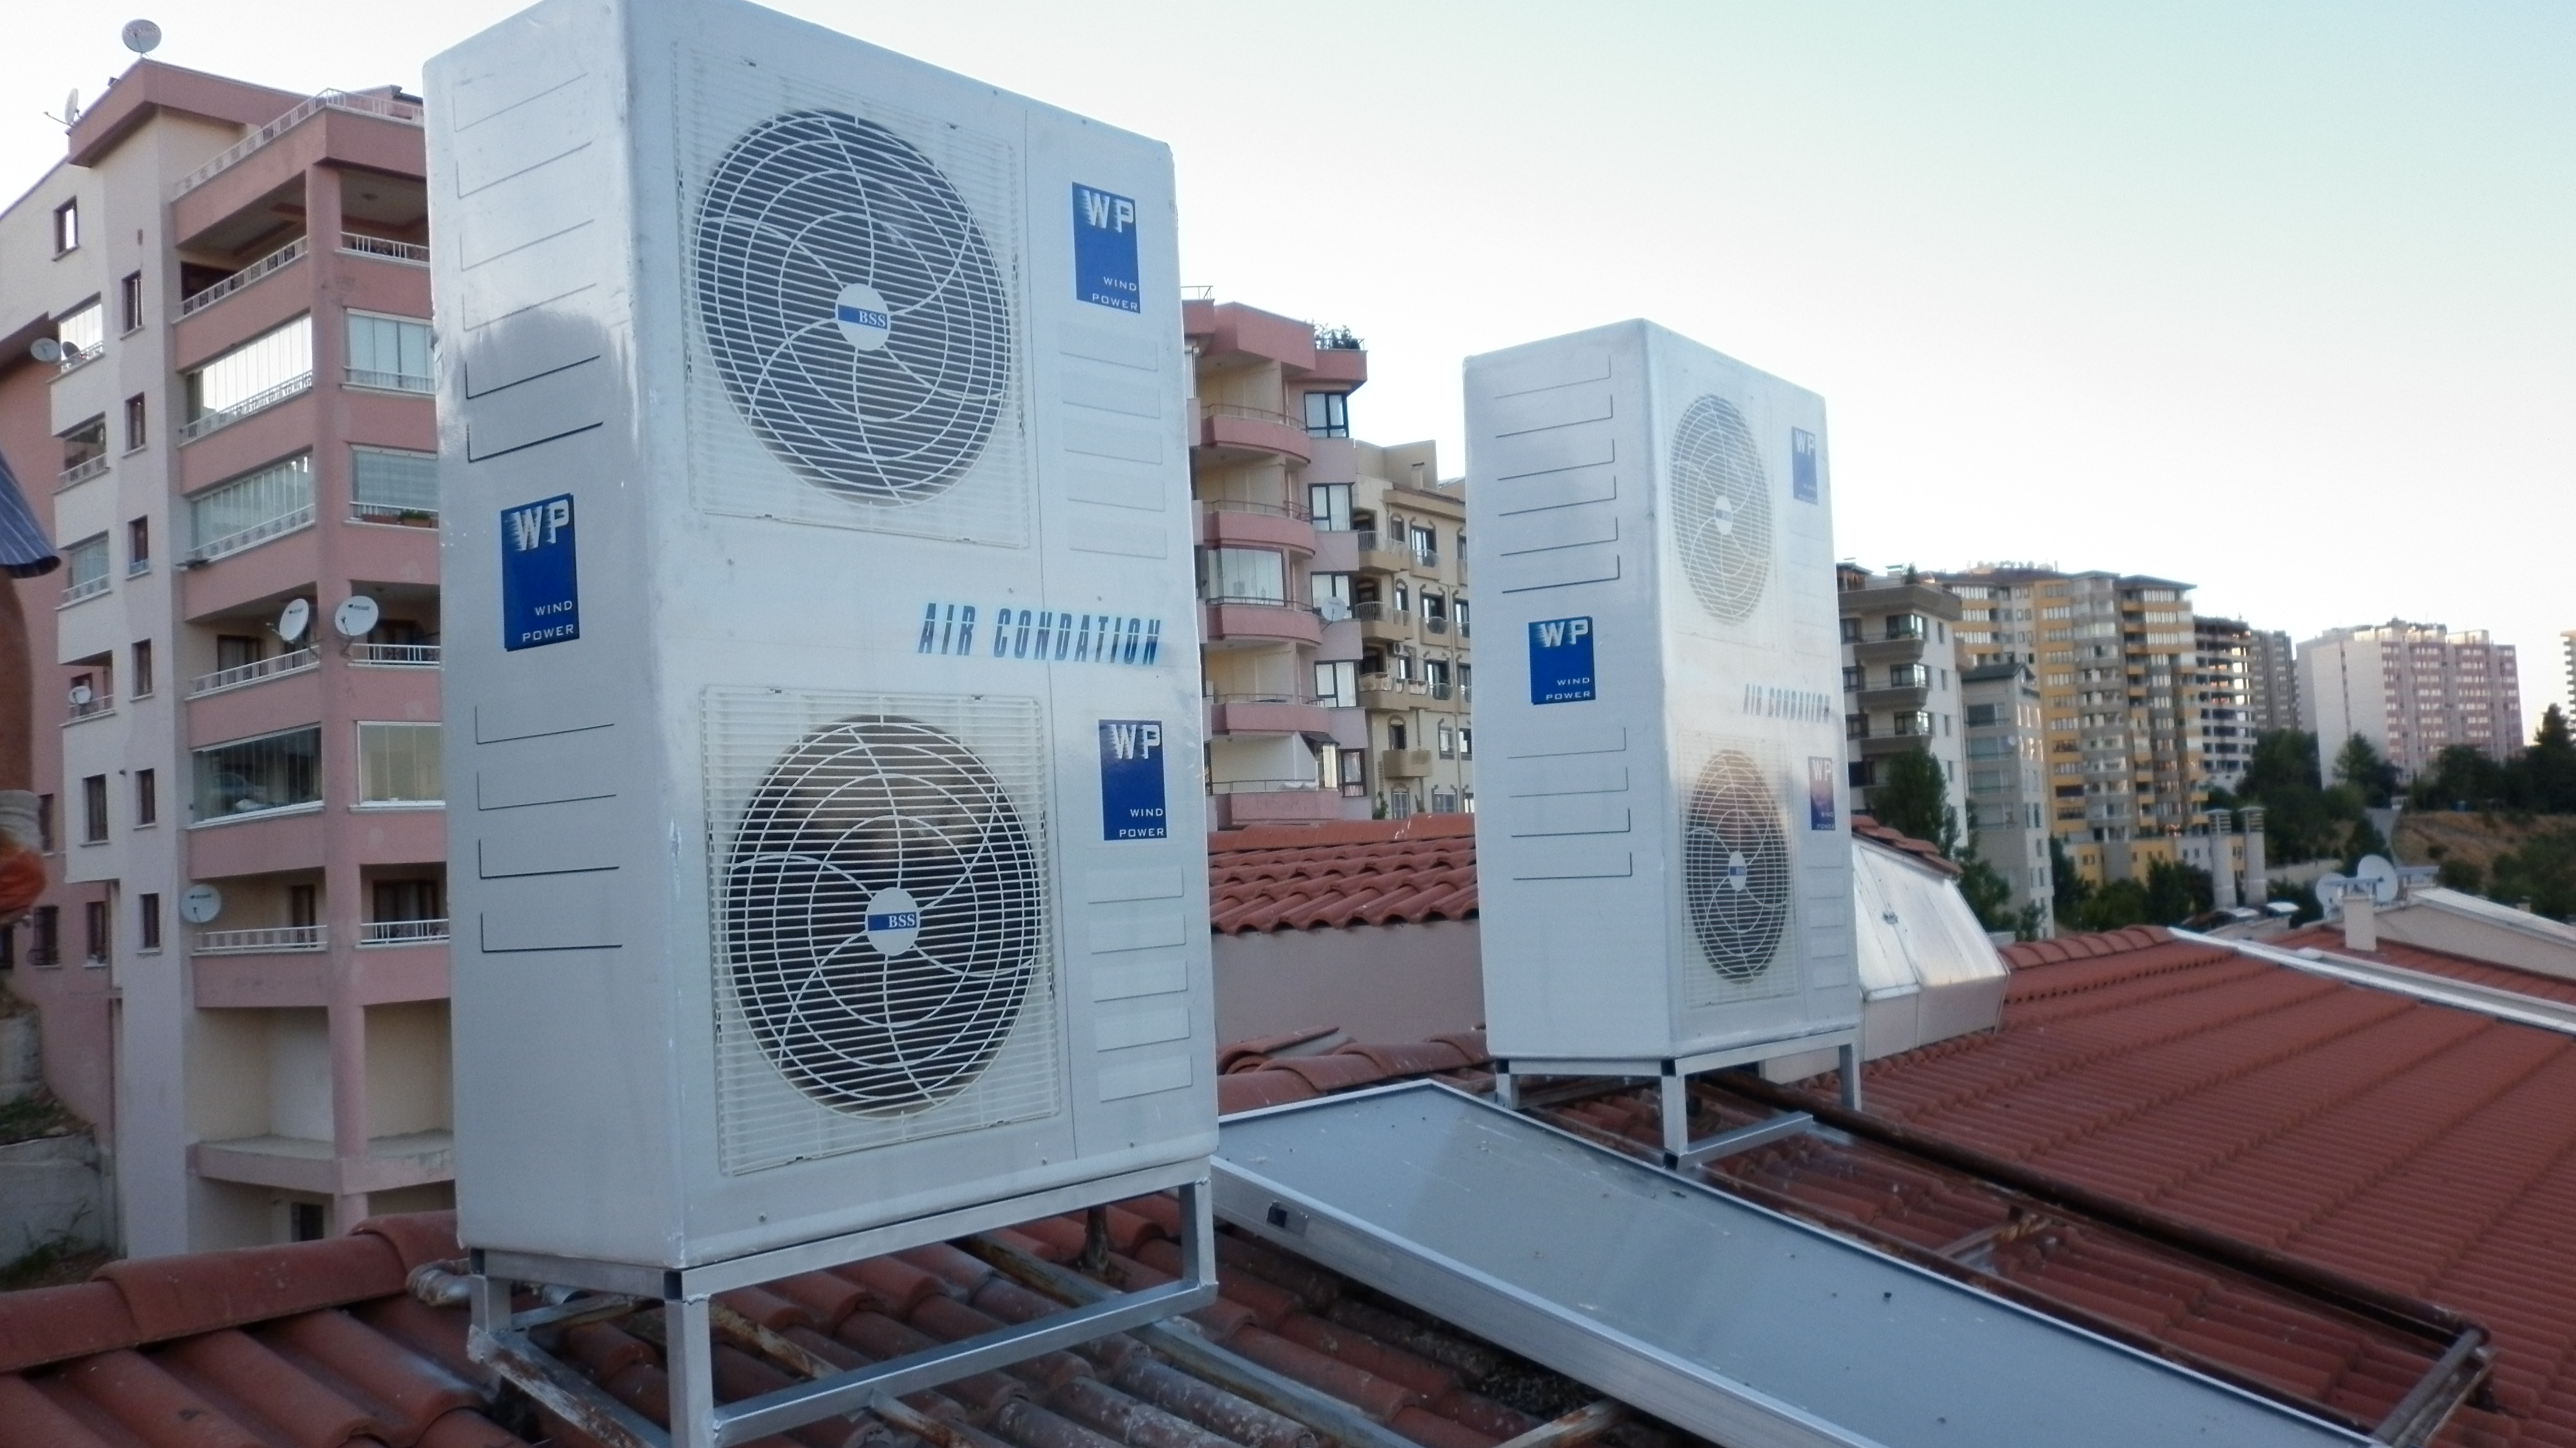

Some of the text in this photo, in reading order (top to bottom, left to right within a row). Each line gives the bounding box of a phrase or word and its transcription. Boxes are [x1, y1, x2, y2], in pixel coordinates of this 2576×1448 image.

[1079, 189, 1134, 233] WP
[1103, 276, 1137, 291] WIND
[1092, 293, 1138, 311] POWER
[858, 310, 886, 327] BSS
[511, 499, 569, 551] WP
[535, 600, 573, 616] WIND
[522, 624, 574, 642] POWER
[918, 602, 1160, 665] AIR CONDATION
[1539, 618, 1589, 648] WP
[1557, 677, 1590, 685] WIND
[1546, 691, 1591, 701] POWER
[1108, 724, 1160, 759] WP
[1812, 759, 1832, 781] WP
[1130, 808, 1164, 817] WIND
[1119, 828, 1164, 837] POWER
[887, 913, 916, 928] BSS
